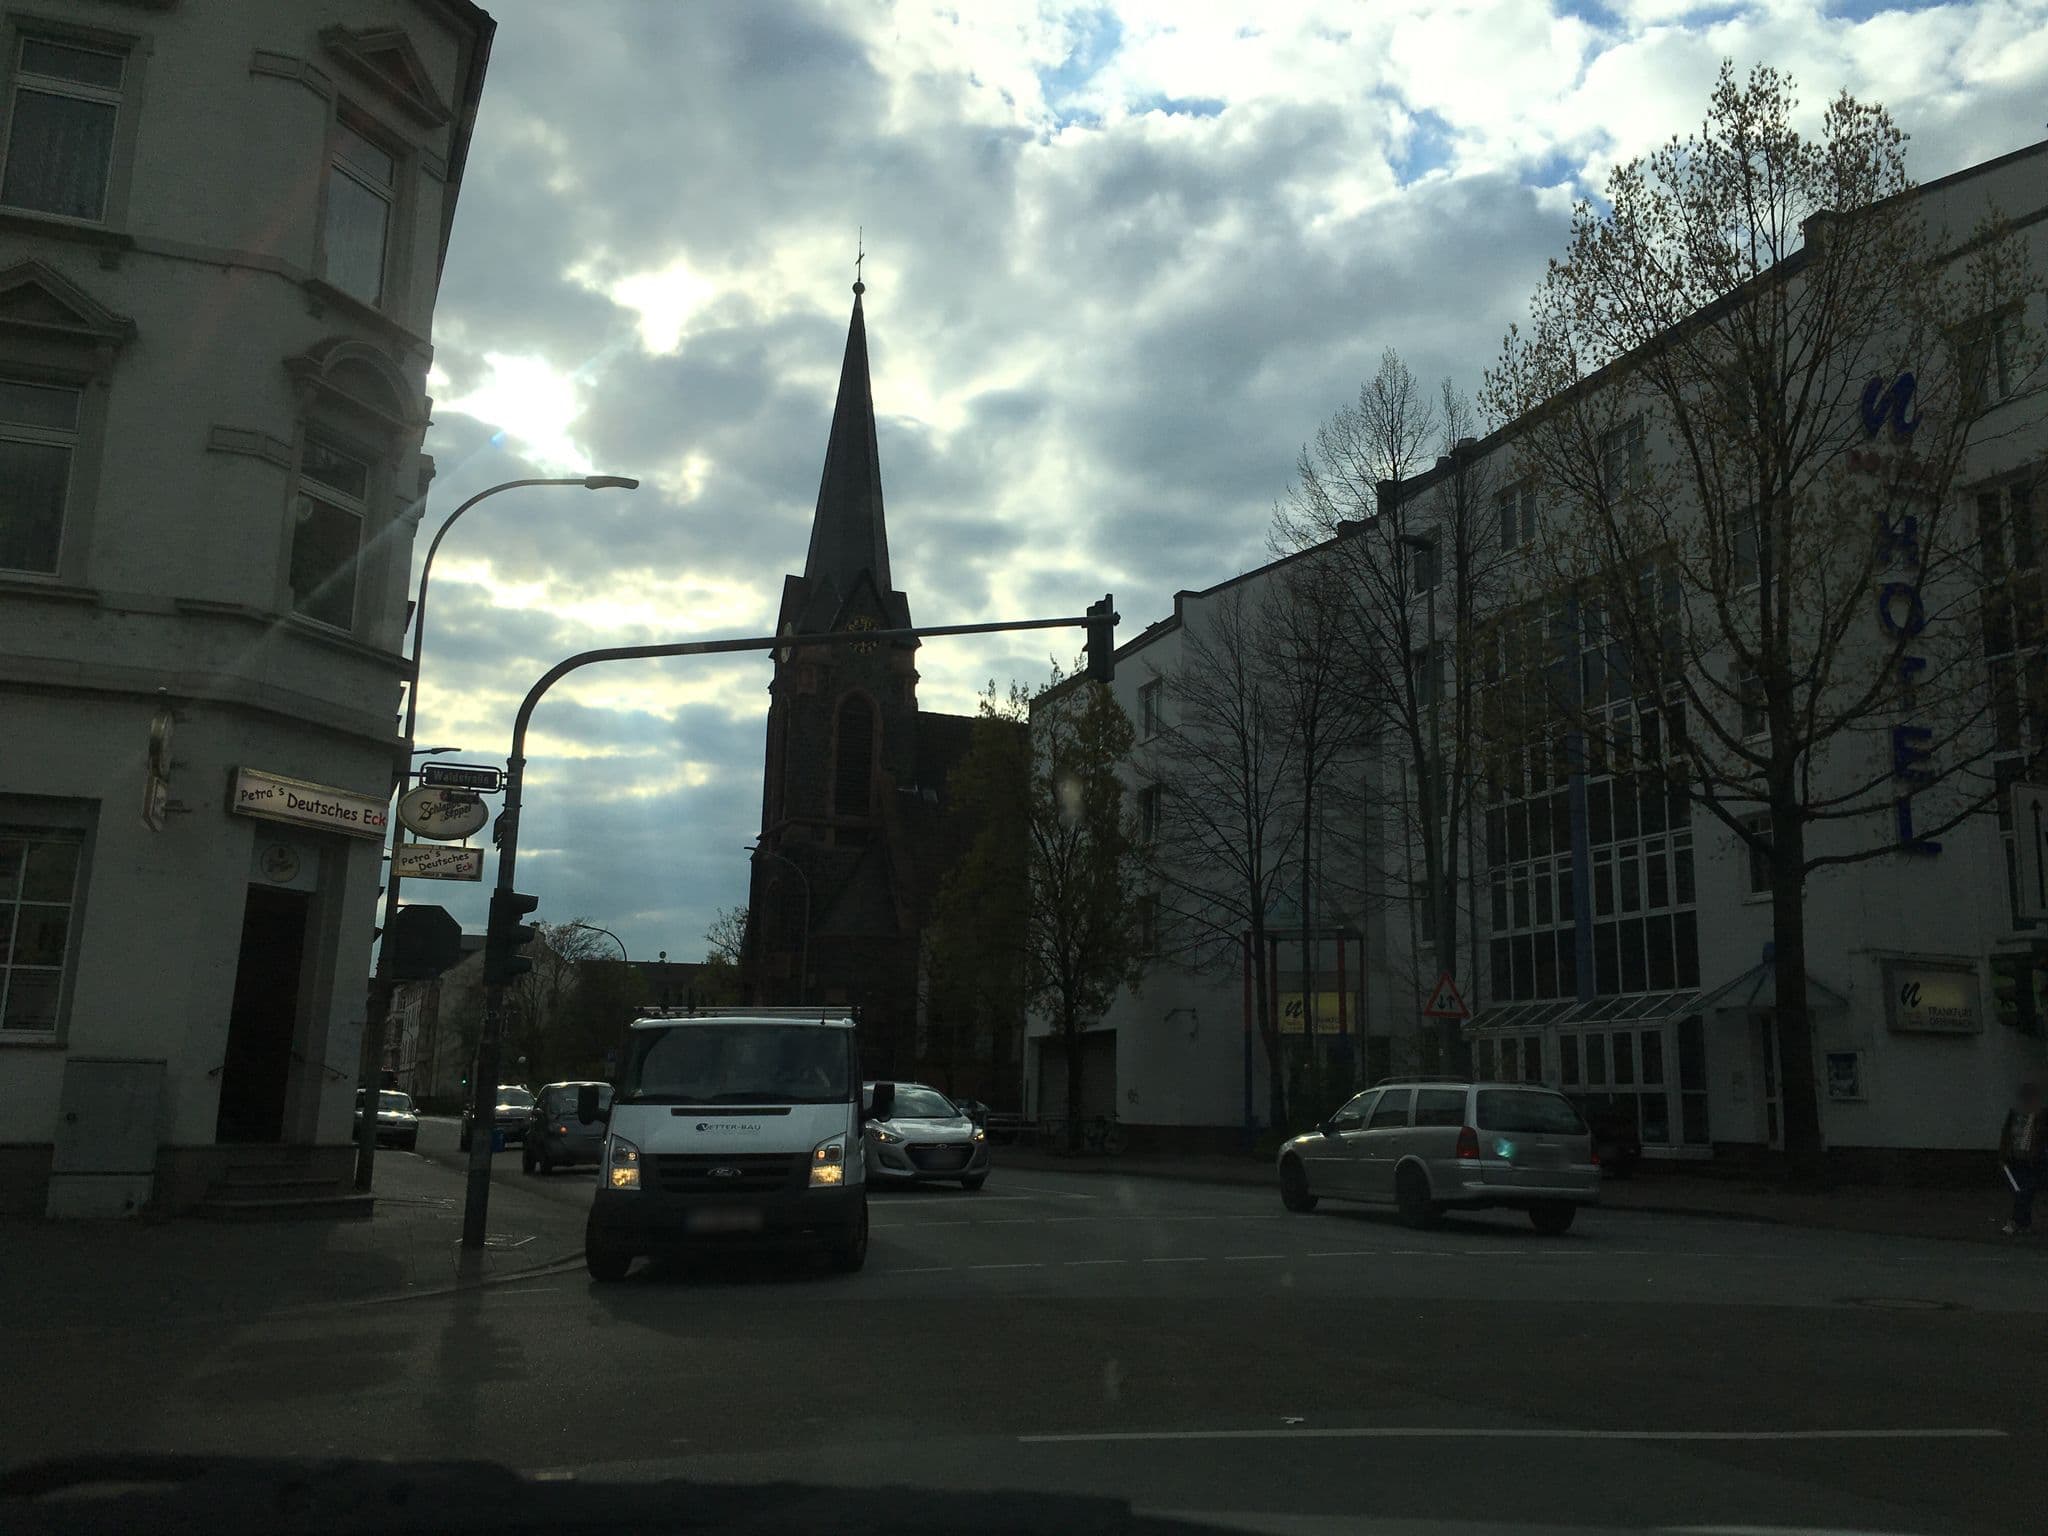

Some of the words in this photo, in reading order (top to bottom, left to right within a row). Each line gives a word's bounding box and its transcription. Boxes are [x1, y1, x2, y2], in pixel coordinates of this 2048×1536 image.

[1875, 510, 1942, 856] HOTEL
[287, 793, 358, 821] Deutsches
[363, 809, 387, 826] Eck
[418, 853, 470, 871] Deutsches
[455, 862, 473, 873] Eck
